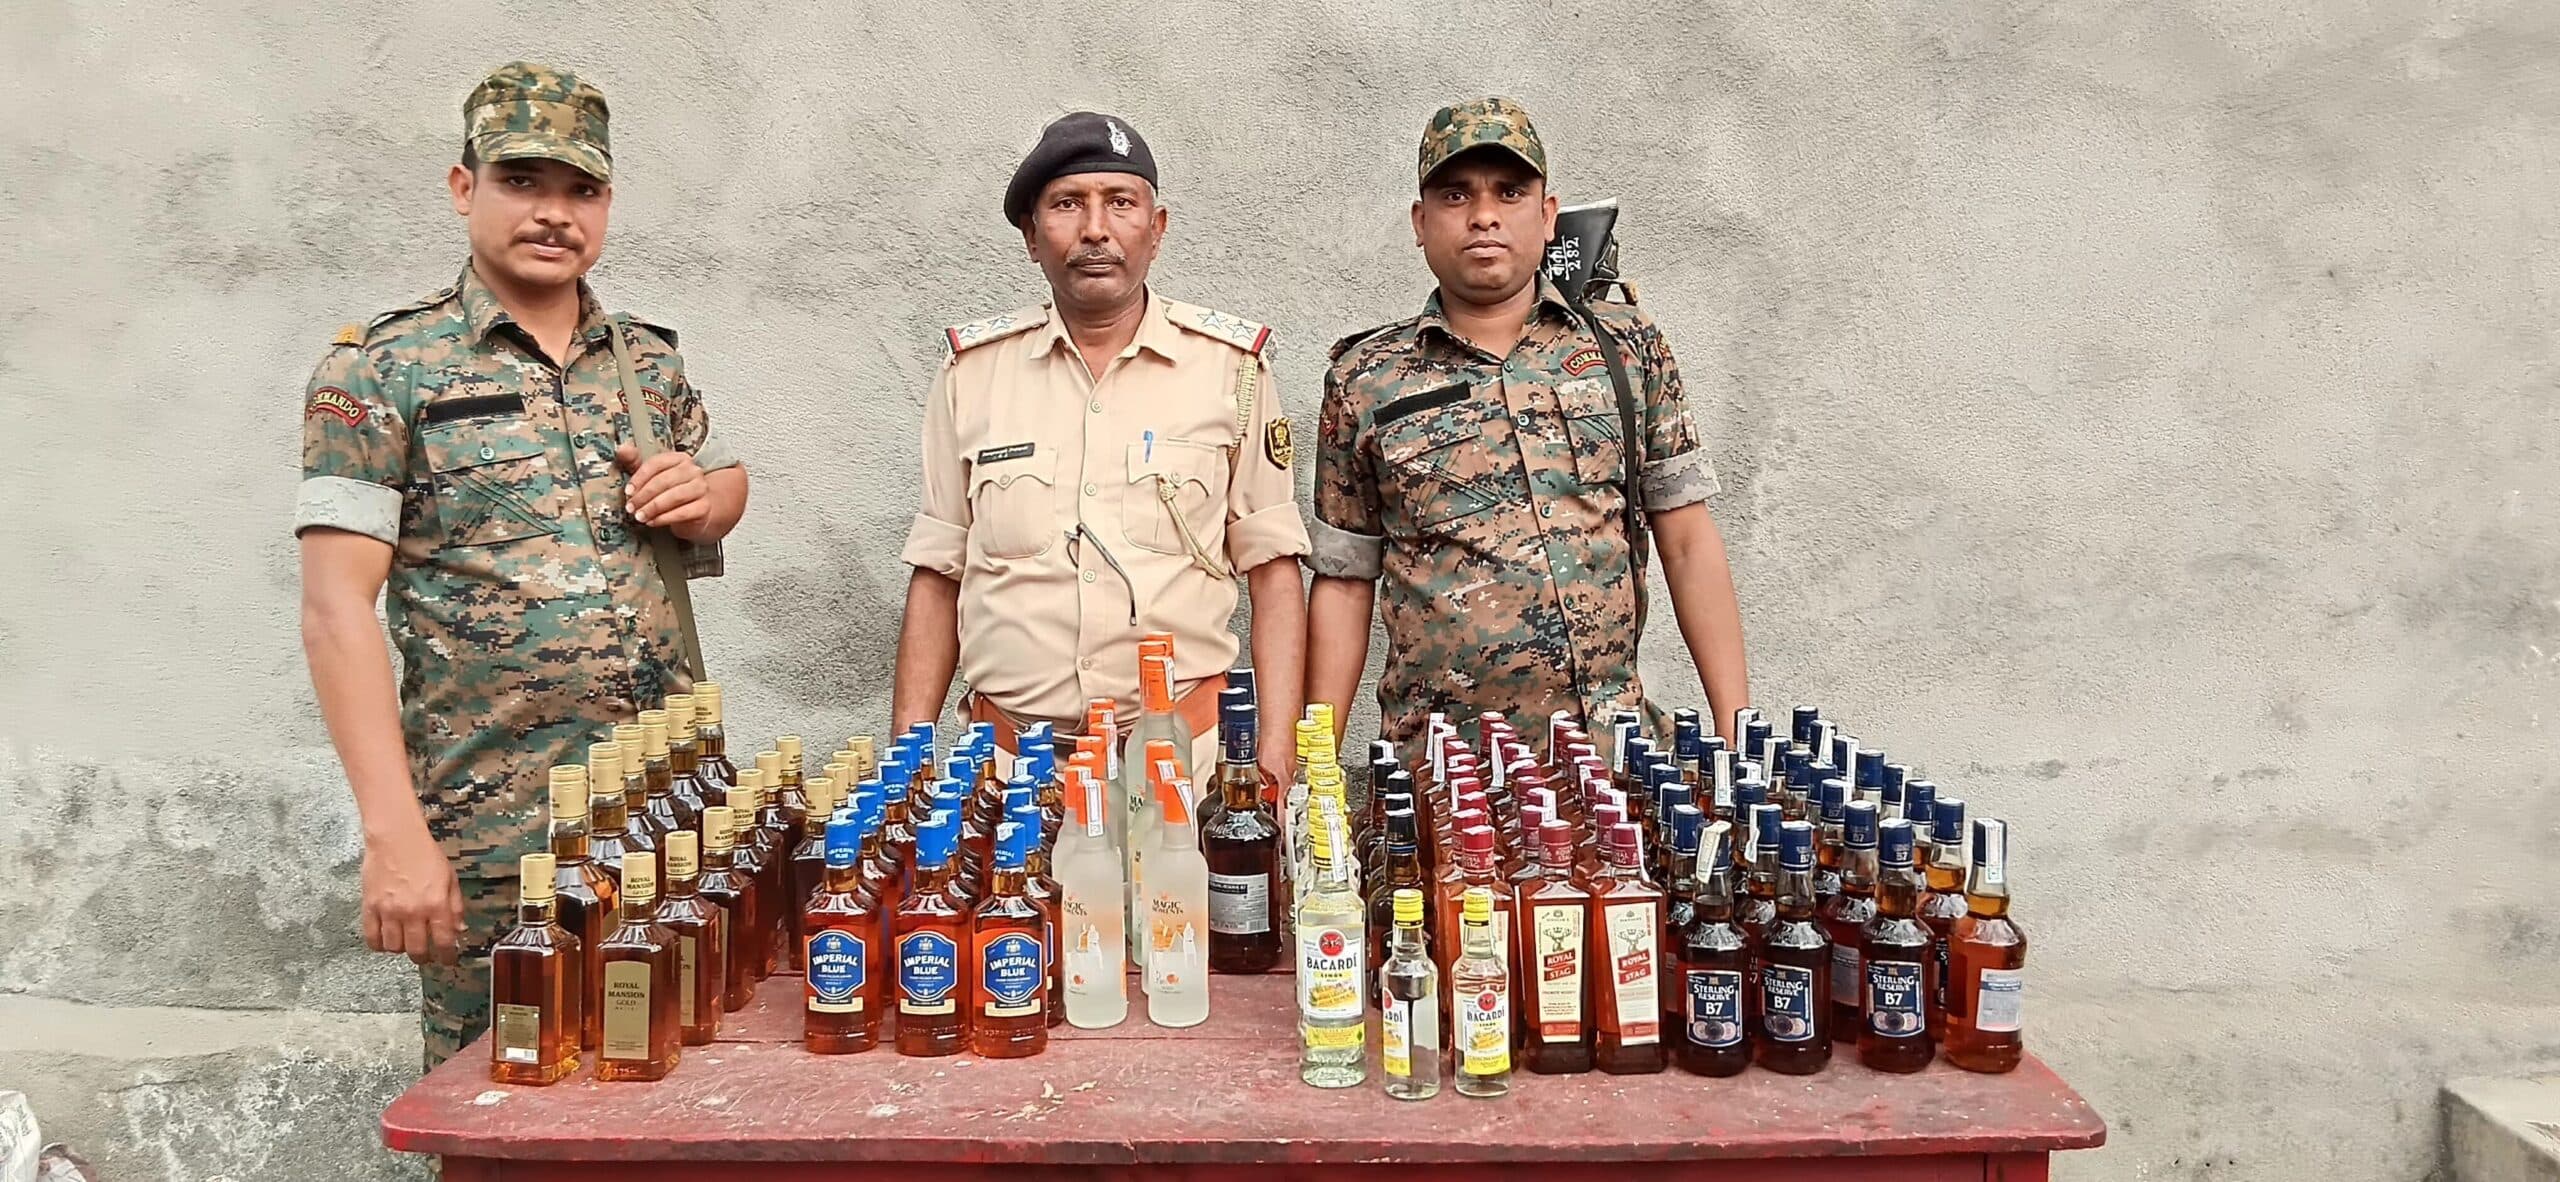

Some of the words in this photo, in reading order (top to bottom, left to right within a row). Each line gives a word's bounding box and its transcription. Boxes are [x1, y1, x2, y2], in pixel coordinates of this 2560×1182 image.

[1566, 236, 1581, 271] 282
[1570, 351, 1605, 369] COMMA
[1153, 899, 1181, 909] MAGIC
[812, 954, 858, 966] IMPERIAL
[904, 955, 950, 968] IMPERIAL
[989, 957, 1036, 970] IMPERIAL
[1306, 952, 1357, 970] BACARDÍ
[1546, 954, 1574, 966] ROYAL
[1621, 954, 1649, 968] ROYAL
[821, 964, 846, 973] BLUE
[913, 966, 938, 975] BLUE
[1000, 968, 1025, 977] BLUE
[1549, 967, 1571, 979] STAG
[1625, 969, 1646, 981] STAG
[1873, 974, 1914, 985] STERLING
[613, 981, 640, 989] ROYAL
[1693, 984, 1735, 994] STERLING
[1764, 976, 1804, 991] STERLING
[608, 990, 645, 998] MANSION
[1885, 992, 1903, 1005] B7
[1705, 1002, 1723, 1015] B7
[1774, 995, 1791, 1010] B7
